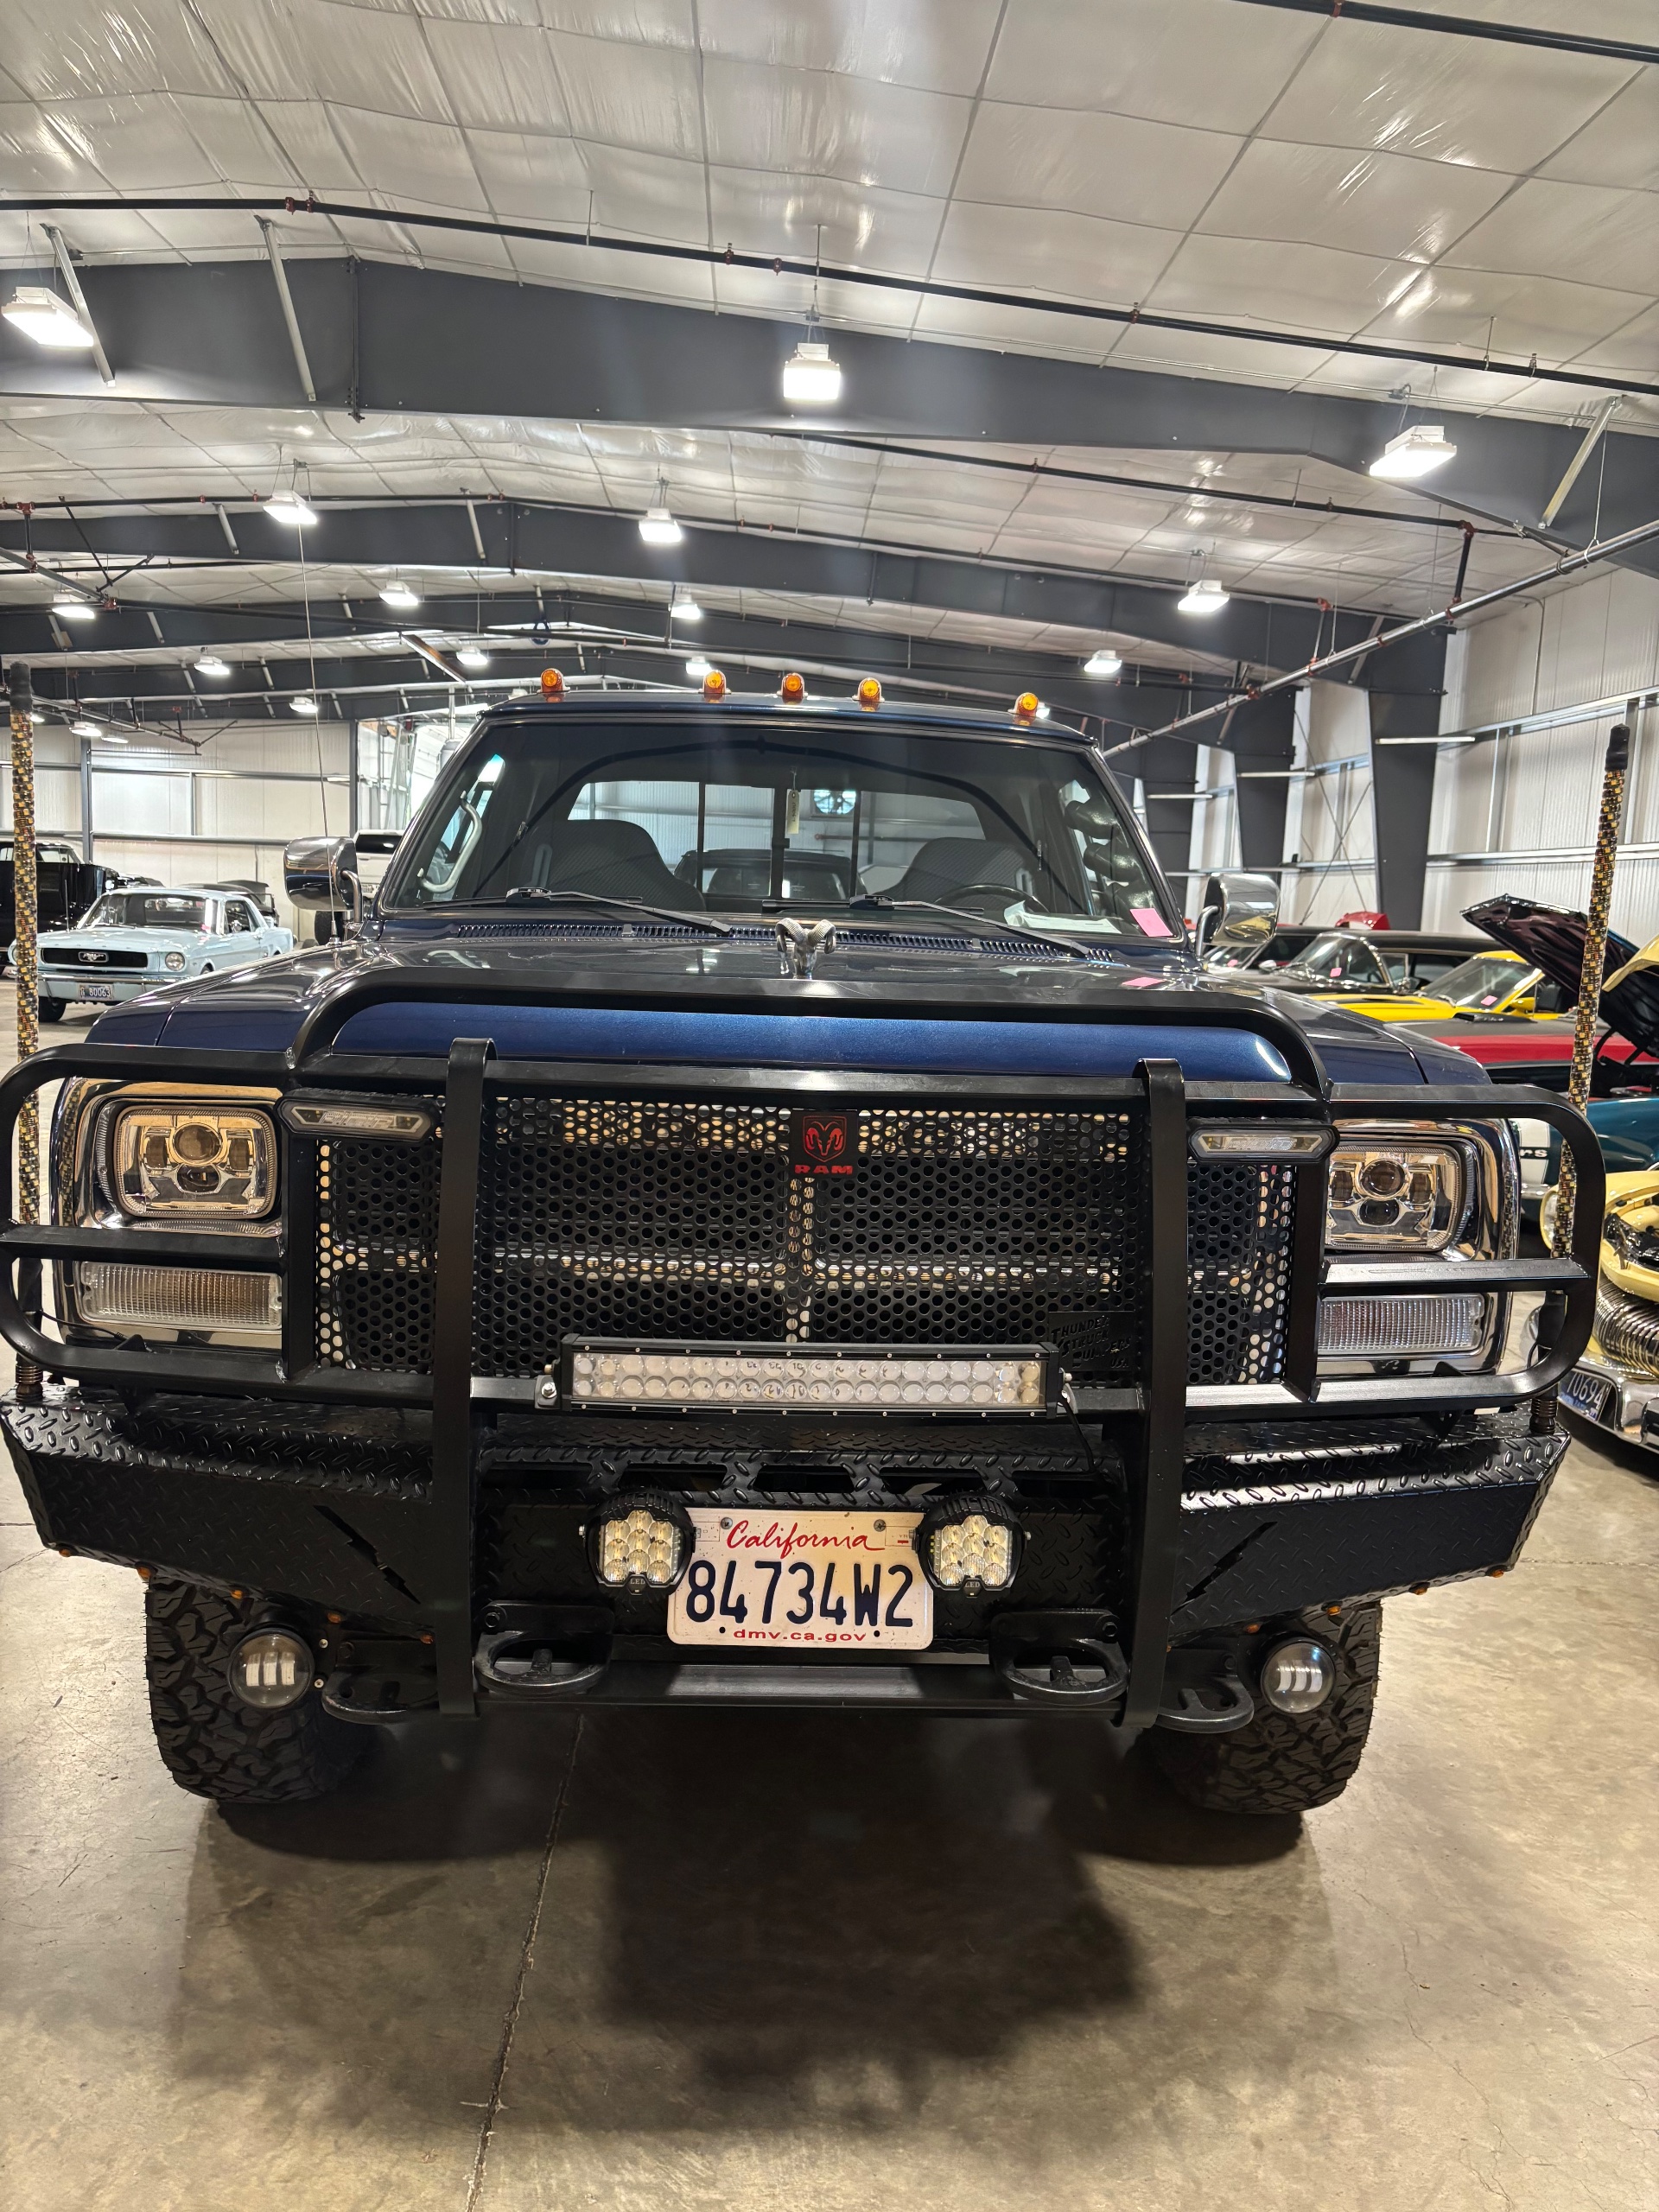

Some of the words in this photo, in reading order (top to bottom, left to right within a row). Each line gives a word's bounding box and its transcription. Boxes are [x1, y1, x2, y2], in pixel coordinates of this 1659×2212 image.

[795, 1165, 853, 1174] RAM
[727, 1520, 886, 1559] California
[686, 1560, 913, 1627] 84734W2
[734, 1629, 867, 1642] dmv.ca.gov
